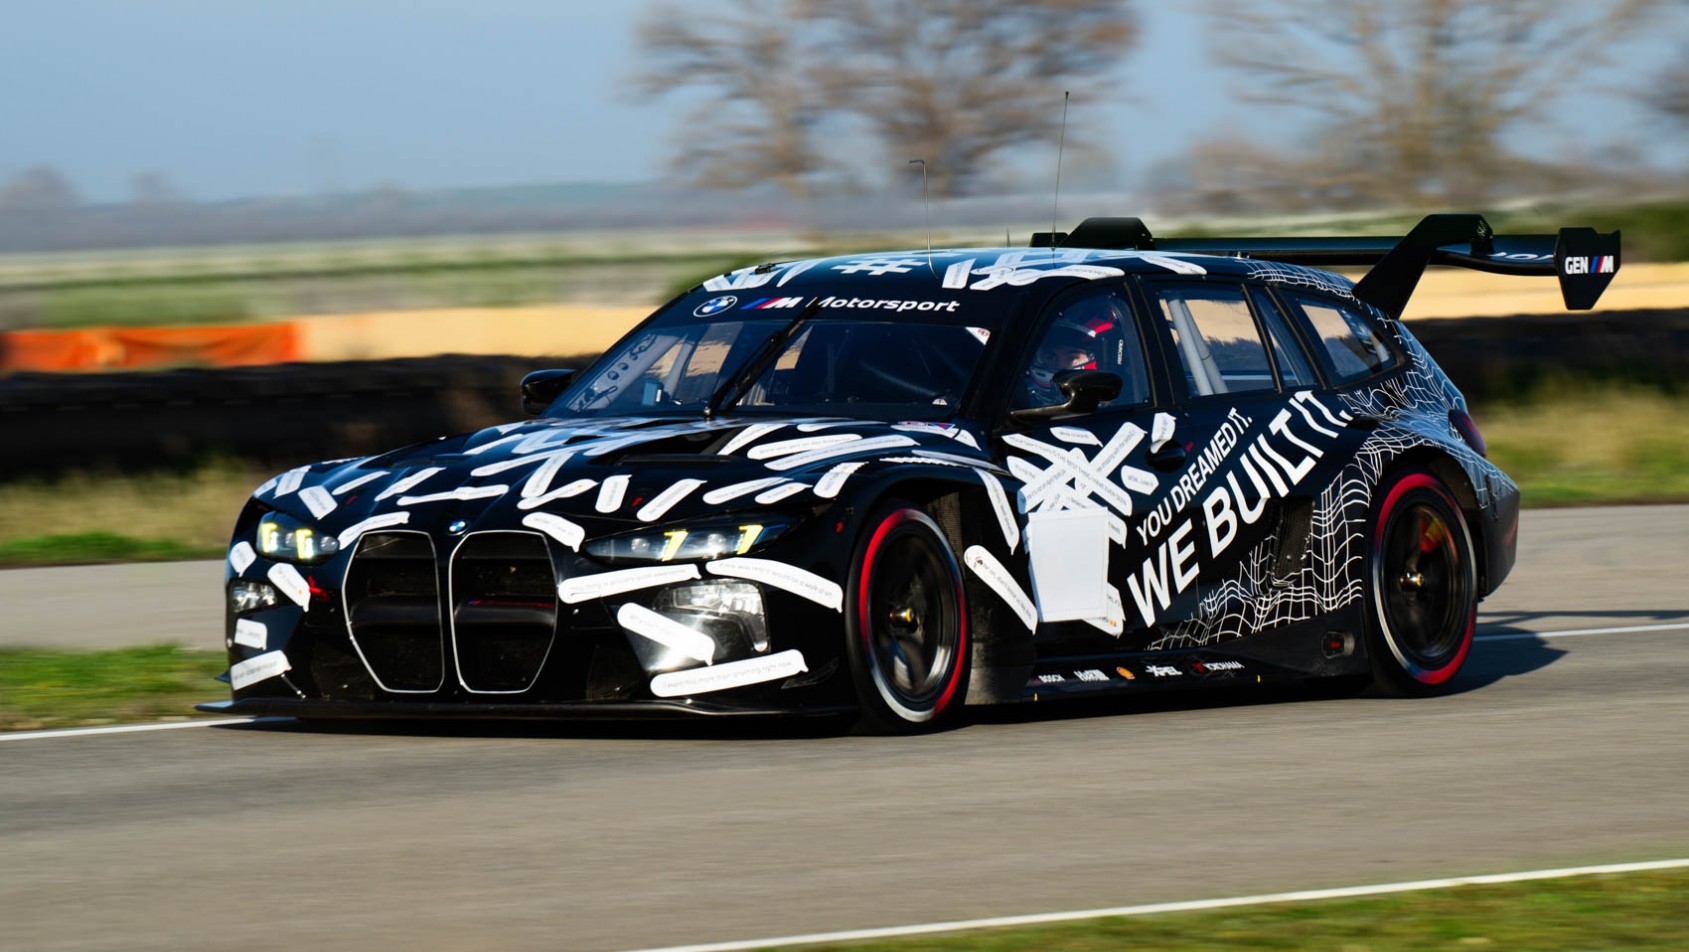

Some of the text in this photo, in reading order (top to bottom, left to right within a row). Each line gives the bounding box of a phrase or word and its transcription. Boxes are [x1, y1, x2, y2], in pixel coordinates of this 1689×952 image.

[754, 296, 804, 309] M
[1565, 256, 1589, 275] GEN
[1596, 255, 1614, 274] M
[1126, 517, 1201, 629] WE
[1202, 407, 1325, 560] BUILT
[1288, 390, 1354, 439] IT.
[1135, 497, 1173, 547] YOU
[1170, 422, 1239, 513] DREAMED
[1228, 407, 1253, 435] IT.
